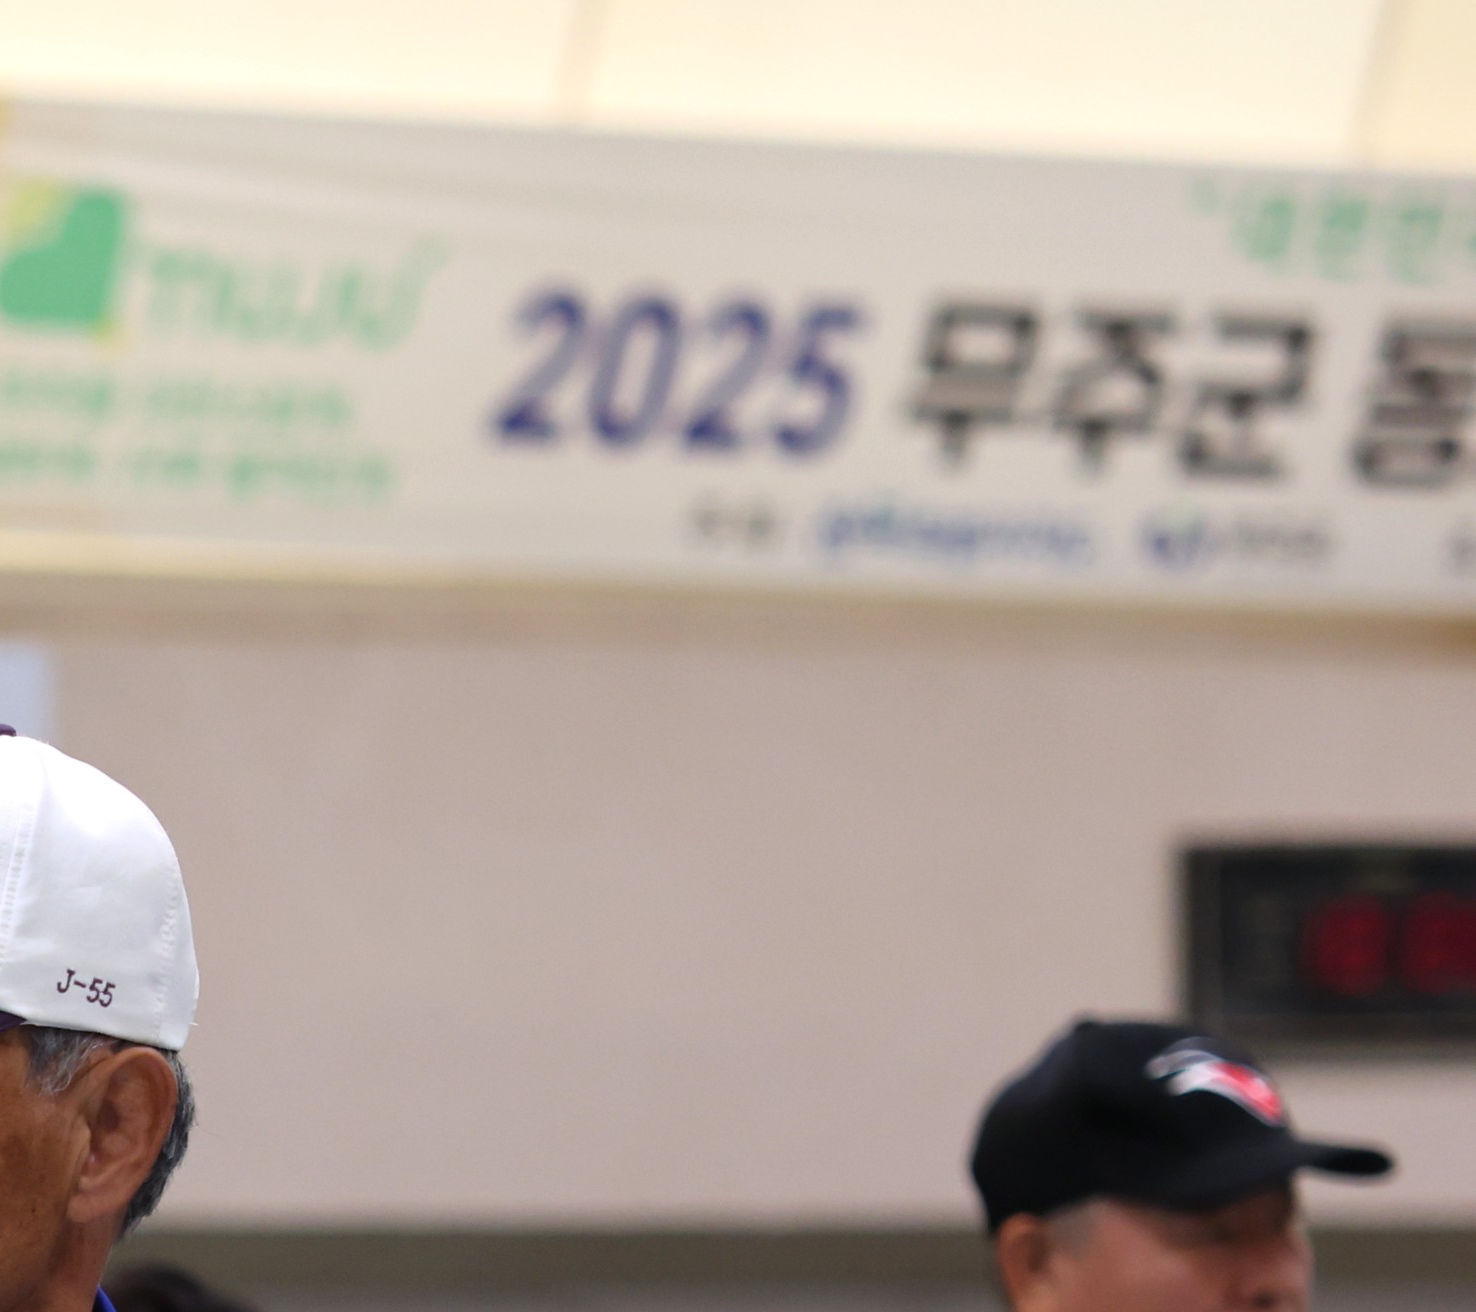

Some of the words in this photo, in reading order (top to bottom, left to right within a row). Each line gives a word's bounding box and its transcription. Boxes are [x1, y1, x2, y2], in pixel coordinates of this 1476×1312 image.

[487, 285, 867, 460] 2025
[905, 293, 1318, 484] 무주군
[56, 967, 117, 1009] J-55
